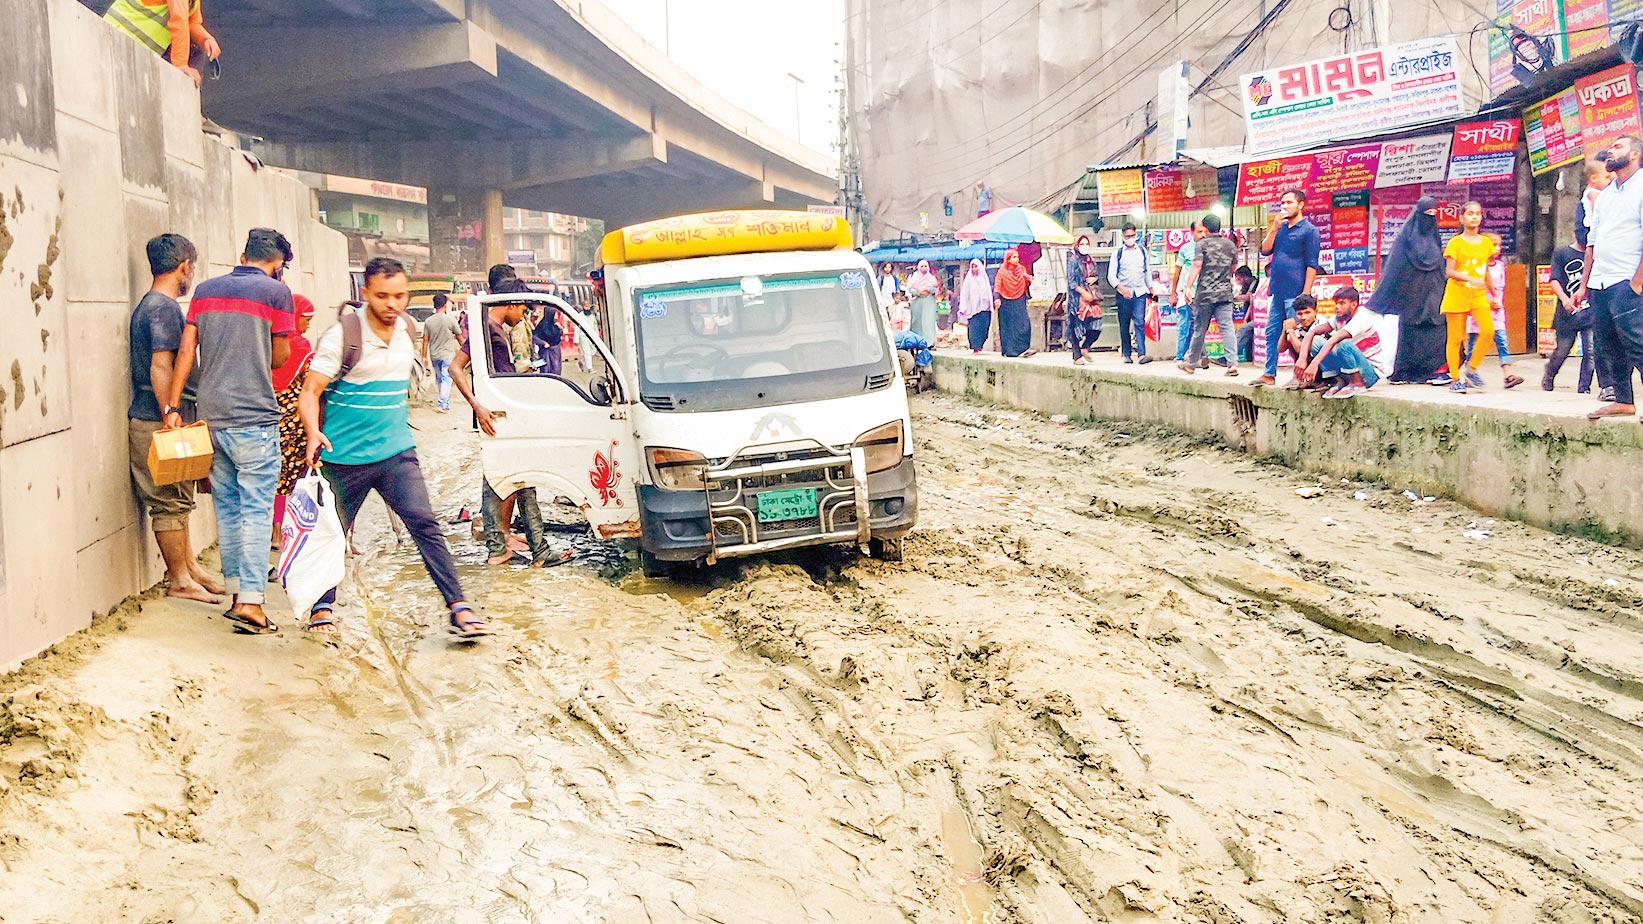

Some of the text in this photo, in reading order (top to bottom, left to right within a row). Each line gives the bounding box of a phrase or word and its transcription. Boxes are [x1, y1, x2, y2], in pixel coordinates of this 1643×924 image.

[1389, 50, 1452, 77] এন্টারপ্রাইজ
[1578, 74, 1633, 106] একতা
[1458, 121, 1517, 145] সাথী
[1384, 144, 1415, 156] রিশা
[1247, 160, 1283, 177] হাজী
[655, 228, 707, 245] আল্লাহ
[746, 220, 811, 238] শক্তিমান
[761, 497, 779, 506] ঢাকা
[781, 492, 802, 505] মেট্রো
